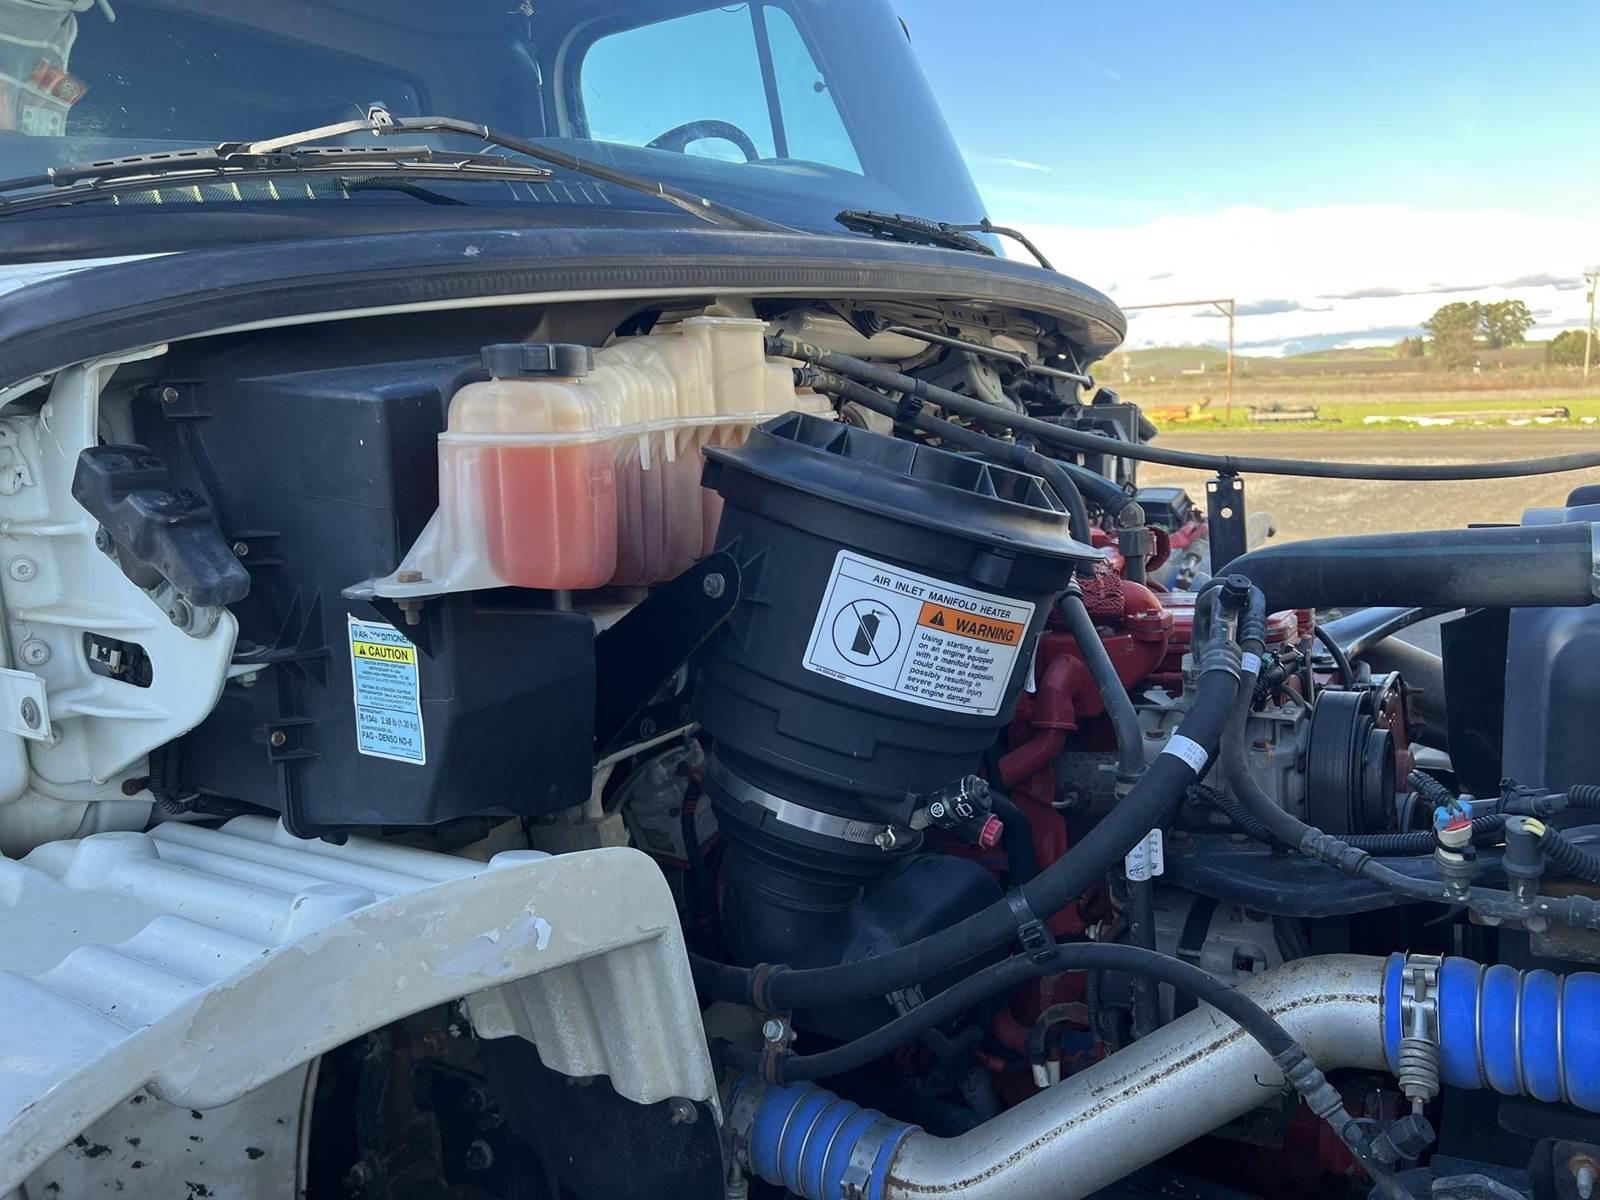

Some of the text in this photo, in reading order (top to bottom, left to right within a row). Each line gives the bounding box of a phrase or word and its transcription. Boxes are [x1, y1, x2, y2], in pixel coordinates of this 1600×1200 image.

[872, 574, 1012, 619] AIR INLET MANIFOLD HEATER
[956, 618, 1014, 642] WARNING
[368, 645, 409, 661] CAUTION
[918, 642, 928, 650] on
[942, 649, 966, 658] engine
[967, 654, 995, 665] equipped
[921, 632, 990, 655] Using starting fluid
[912, 659, 934, 669] could
[935, 665, 956, 675] cause
[916, 651, 931, 659] with
[941, 657, 970, 669] manifold
[971, 663, 989, 672] heater
[907, 675, 984, 698] severe personal injury
[909, 667, 942, 681] possibly
[944, 675, 973, 688] resulting
[903, 683, 919, 692] and
[921, 688, 945, 698] engine
[378, 733, 398, 744] DENSO
